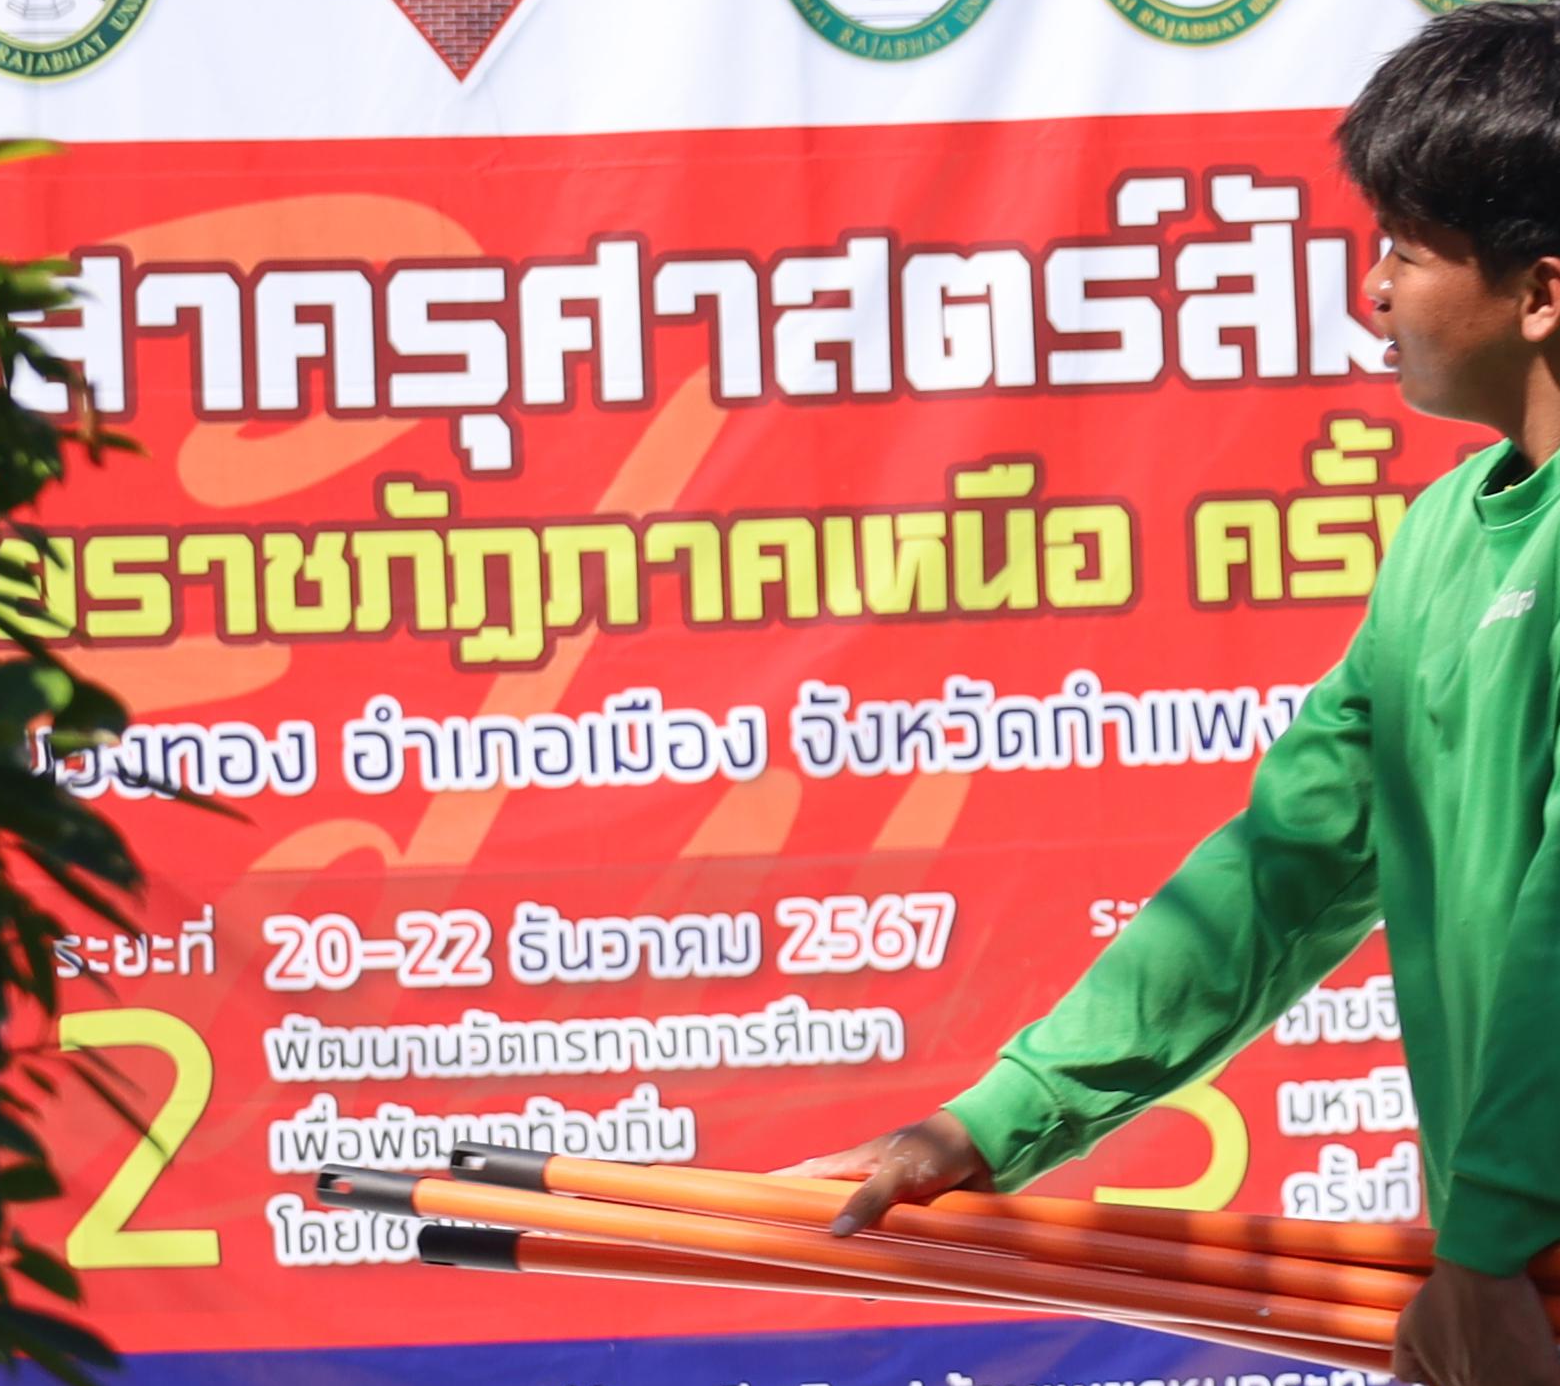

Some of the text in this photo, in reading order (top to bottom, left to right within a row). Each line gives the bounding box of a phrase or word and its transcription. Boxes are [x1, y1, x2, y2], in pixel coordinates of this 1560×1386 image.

[838, 23, 954, 57] RAJABHAT
[1136, 4, 1247, 41] RAJABHAT
[344, 687, 768, 793] อำเภอเมือง
[508, 901, 762, 984] ธันวาคม
[776, 893, 957, 973] 2567
[59, 1007, 220, 1269] 2
